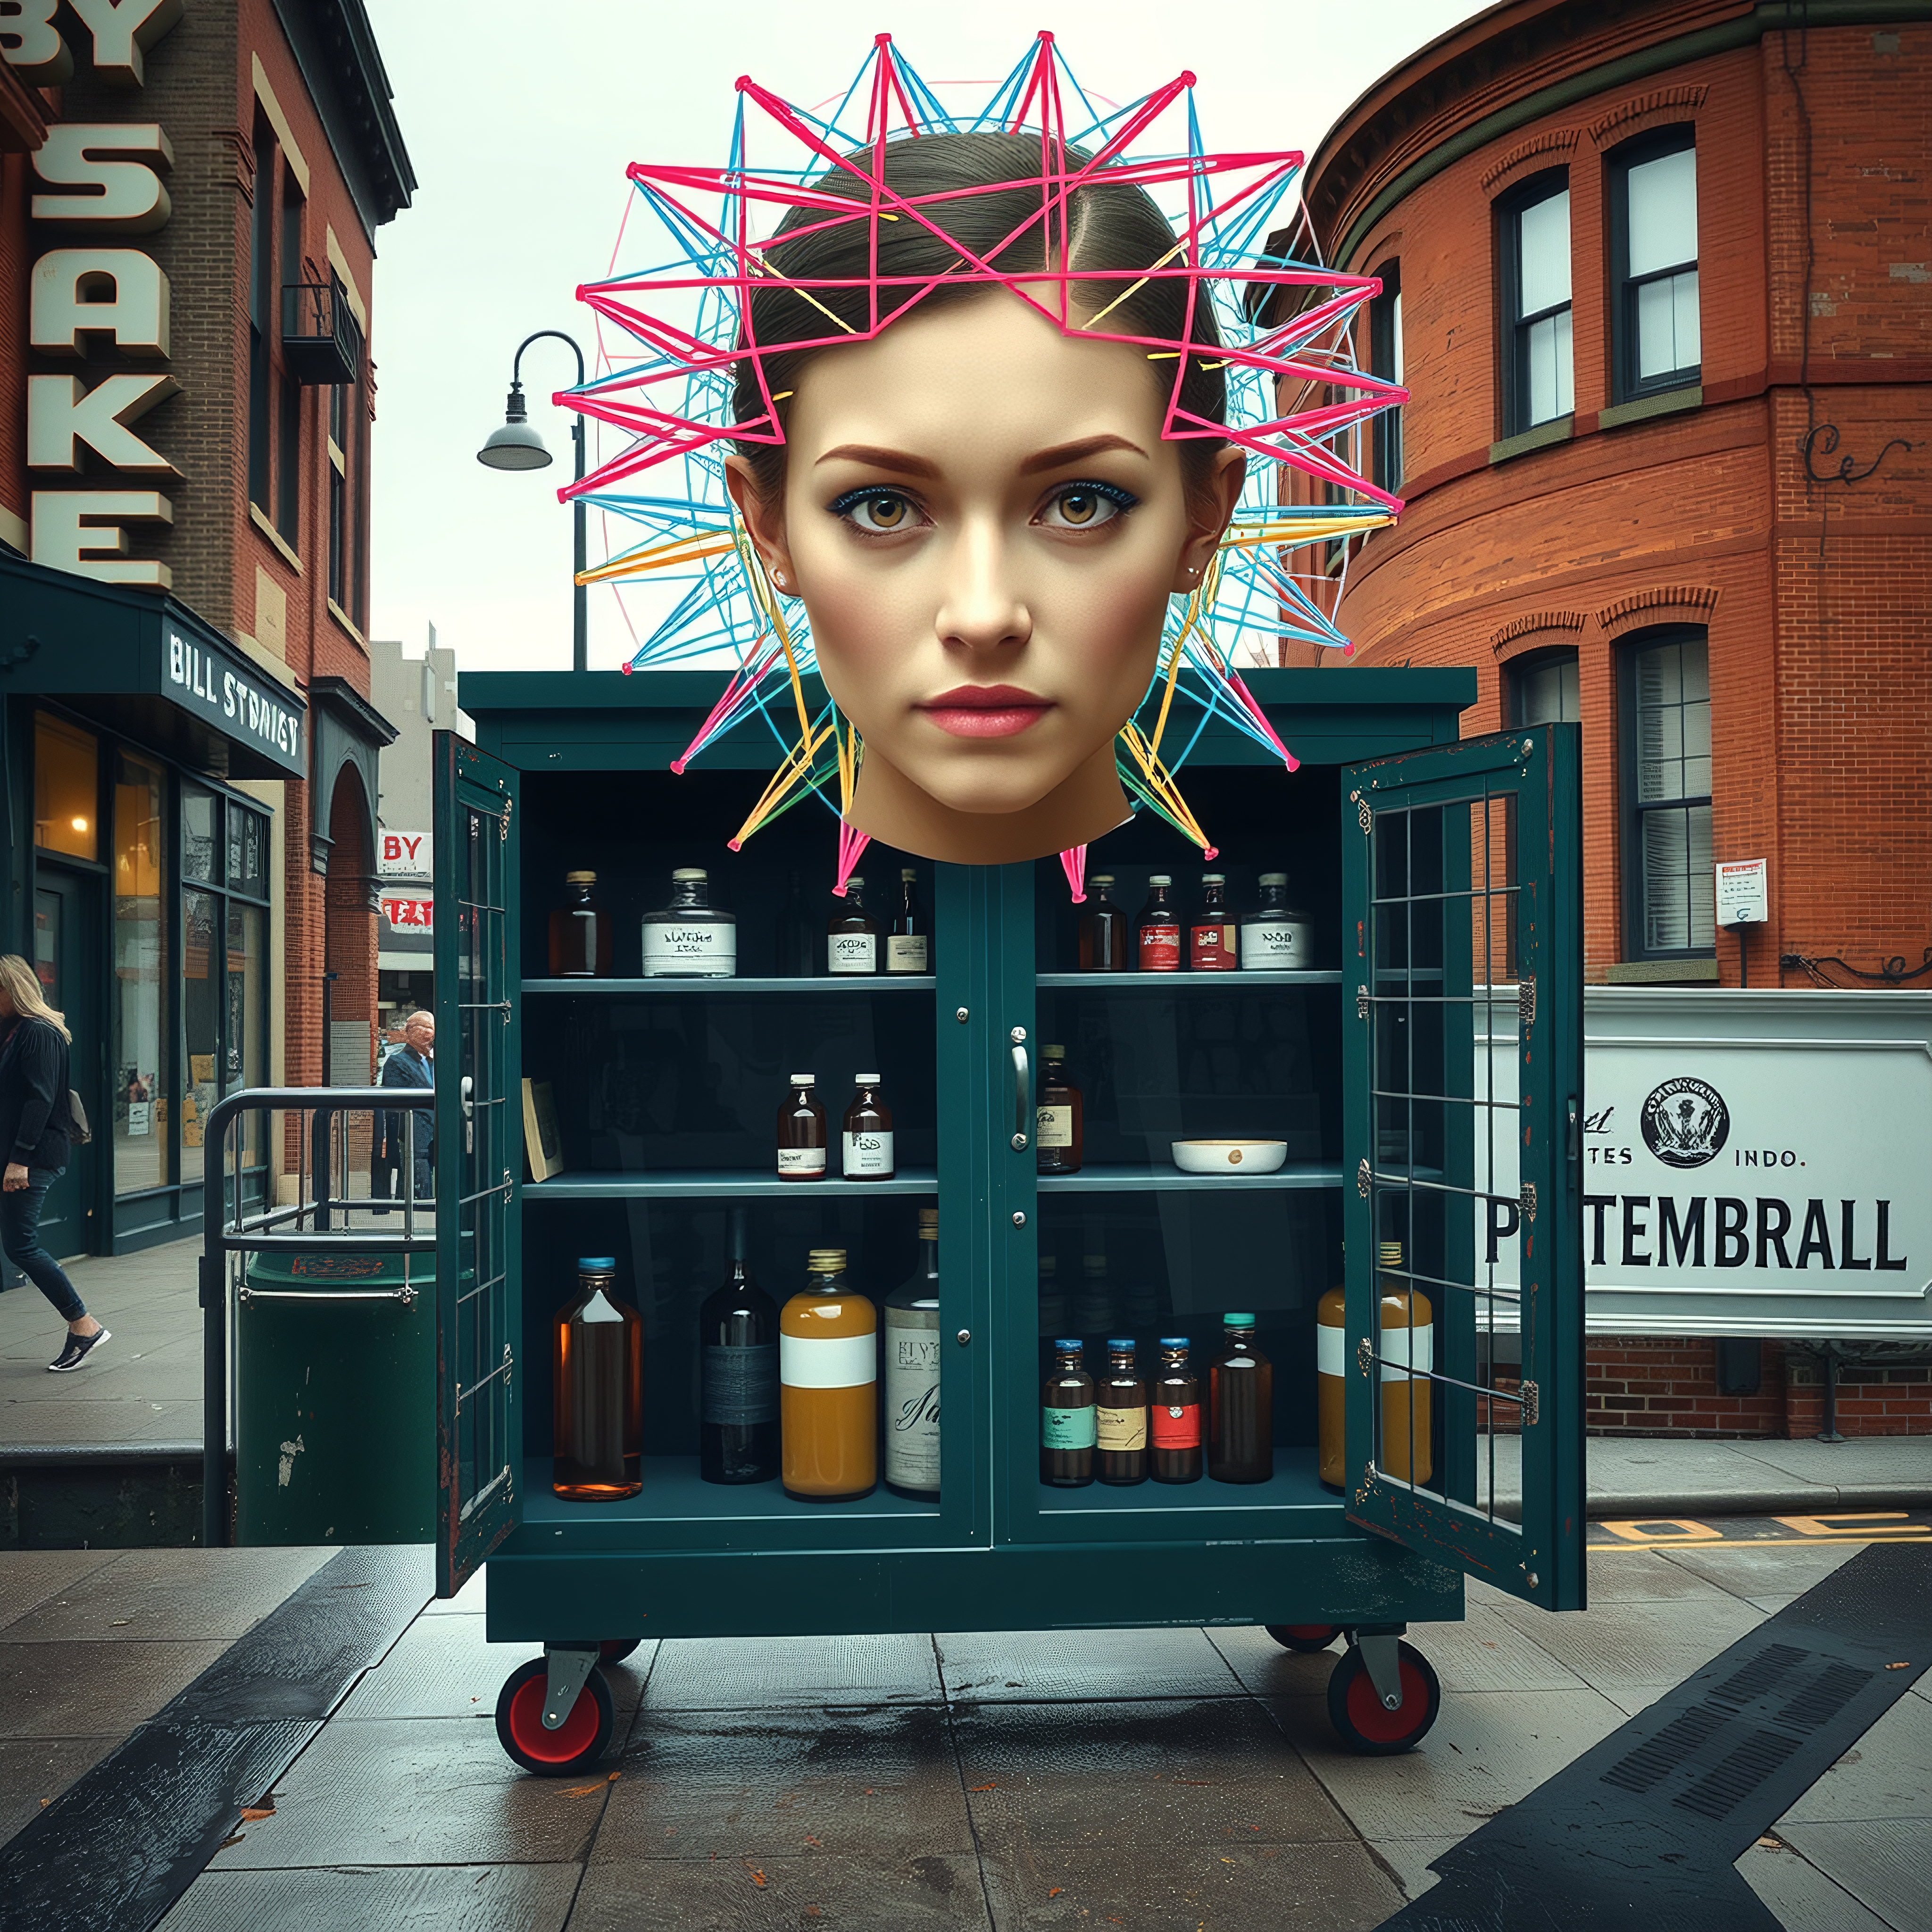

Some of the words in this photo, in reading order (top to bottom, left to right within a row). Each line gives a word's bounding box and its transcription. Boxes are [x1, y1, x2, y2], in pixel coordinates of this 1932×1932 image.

[28, 124, 174, 584] SAKE
[383, 836, 422, 860] BY
[1735, 1149, 1806, 1167] INDO.
